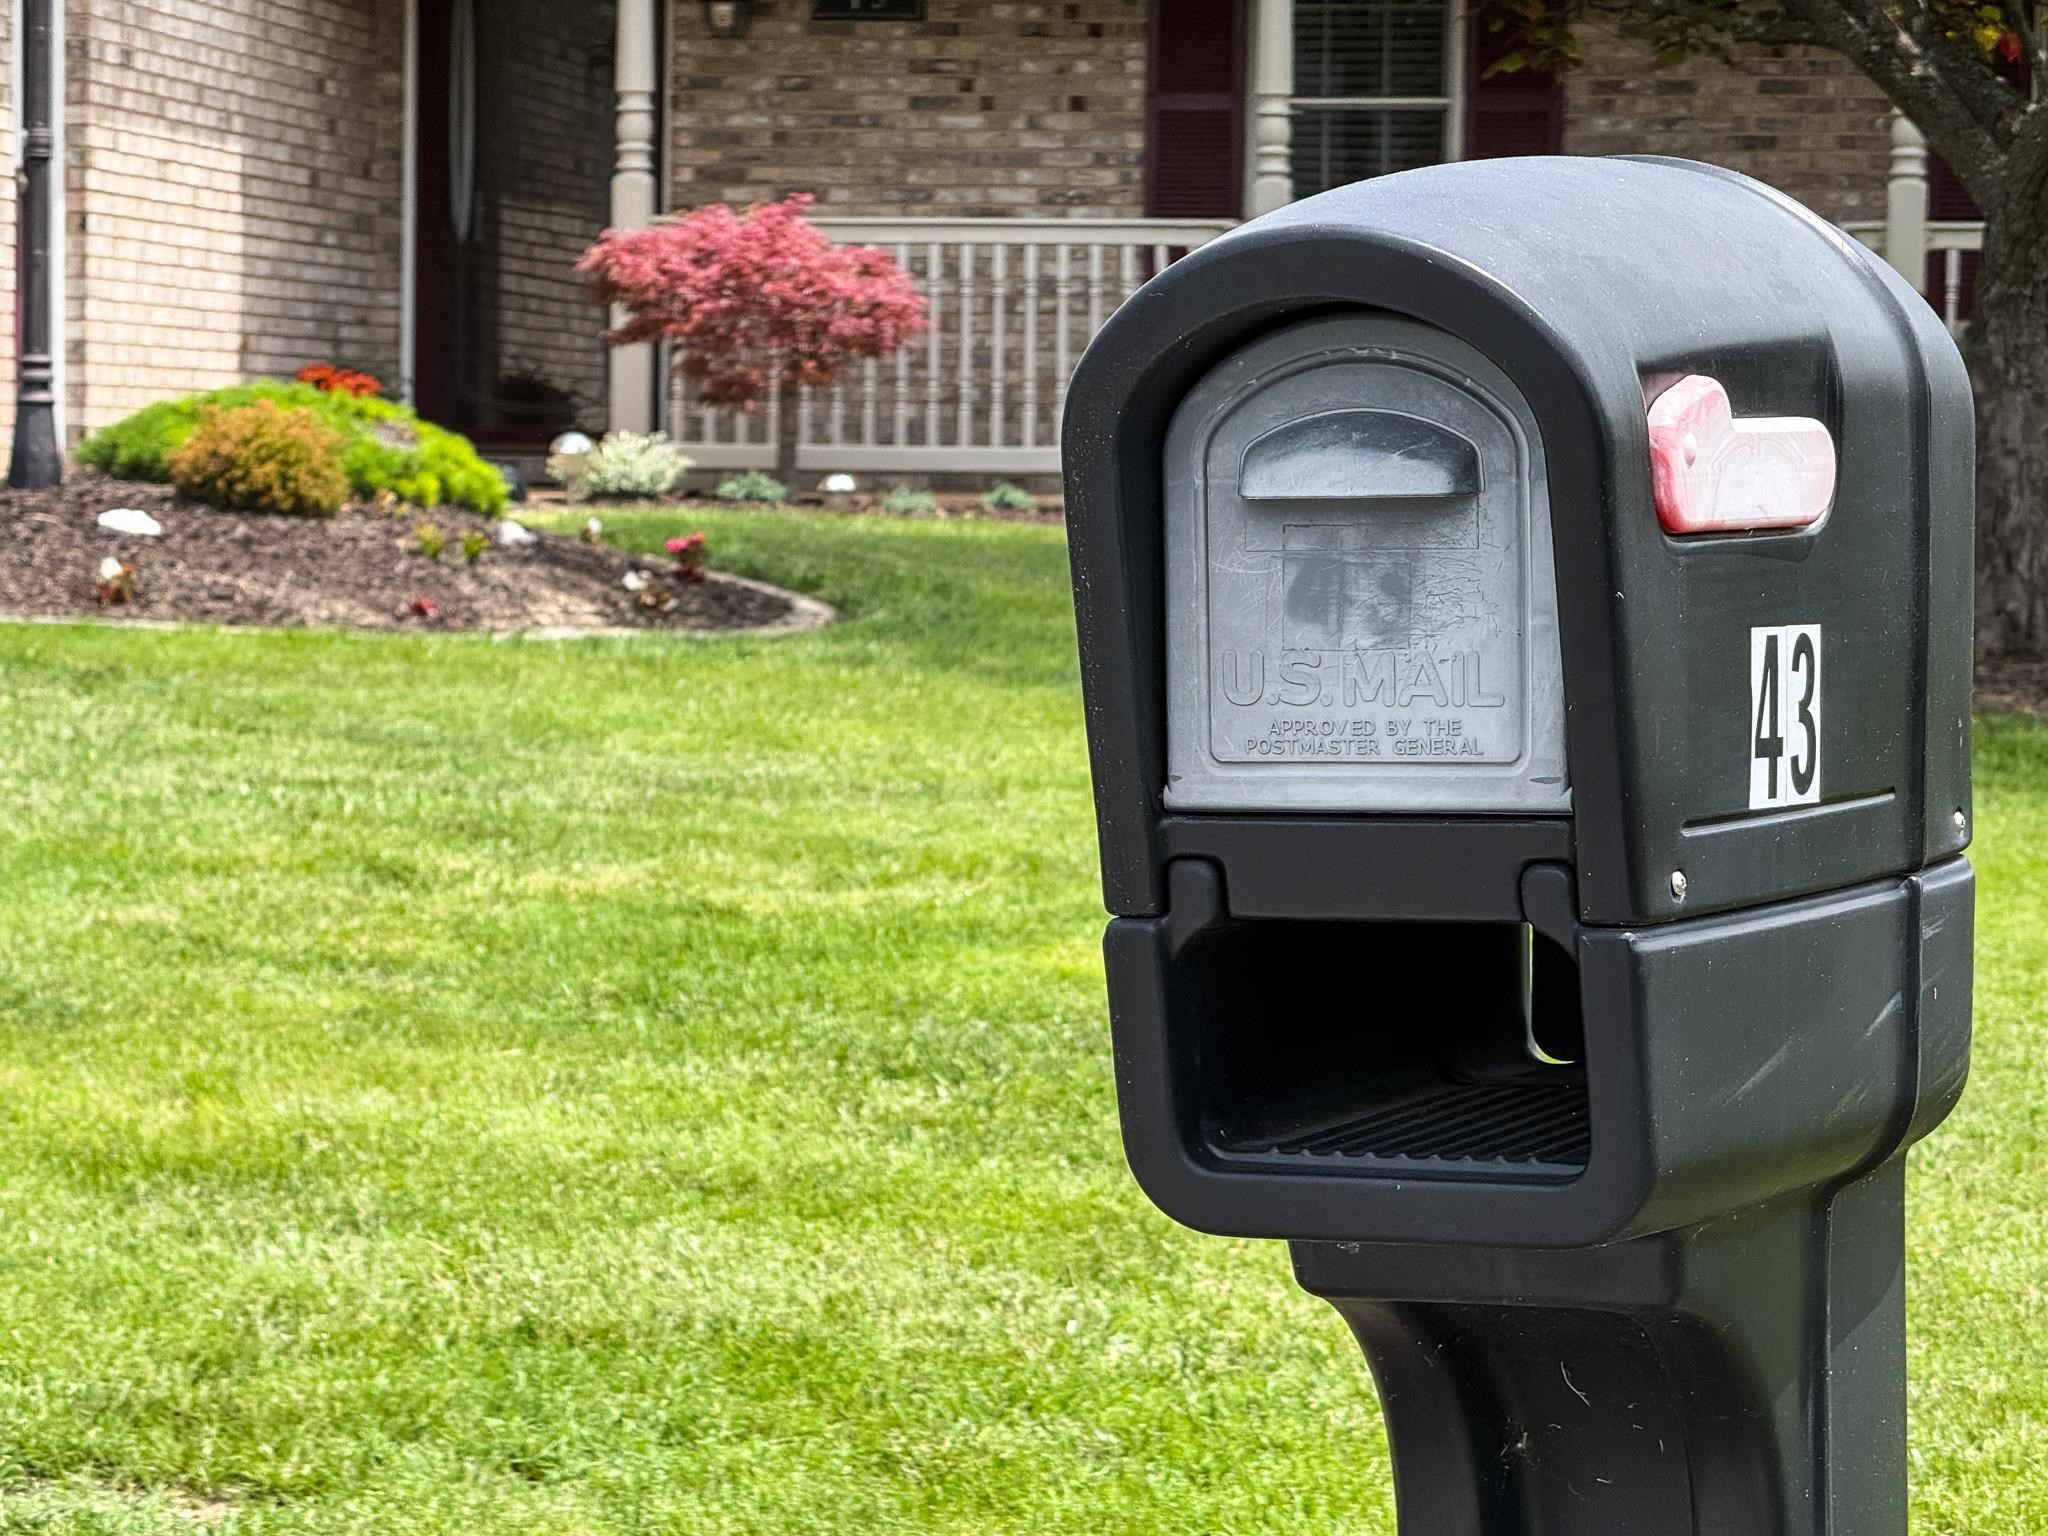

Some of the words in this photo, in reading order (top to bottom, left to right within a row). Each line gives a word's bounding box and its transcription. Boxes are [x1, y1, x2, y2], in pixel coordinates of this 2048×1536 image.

[1222, 650, 1333, 707] U.S.
[1342, 650, 1505, 707] MAIL
[1268, 719, 1375, 736] APPROVED
[1386, 719, 1412, 736] BY
[1423, 719, 1462, 736] THE
[1755, 633, 1817, 799] 43
[1245, 739, 1380, 755] POSTMASTER
[1393, 739, 1484, 755] GENERAL
